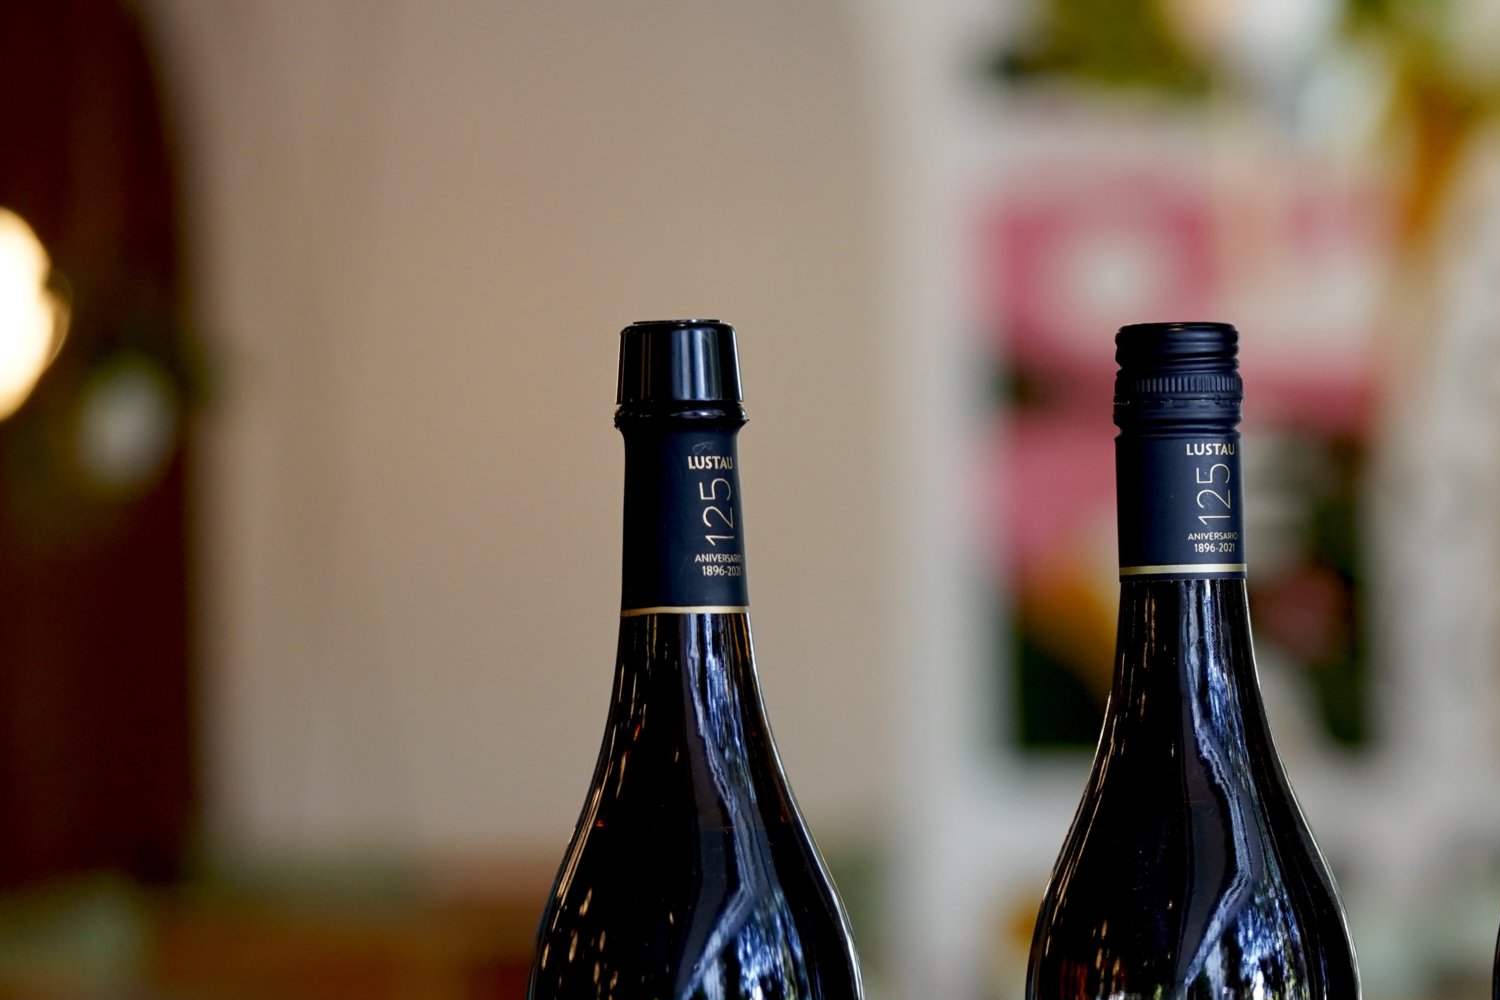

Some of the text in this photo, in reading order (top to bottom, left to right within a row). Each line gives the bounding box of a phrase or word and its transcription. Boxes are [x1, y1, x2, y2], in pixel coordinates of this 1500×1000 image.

[1186, 443, 1236, 456] LUSTAU
[688, 456, 733, 469] LUSTAU
[1196, 463, 1231, 526] 125
[699, 477, 735, 546] 125
[1187, 532, 1238, 541] ANIVERSARIO
[1194, 543, 1235, 553] 1896-2021
